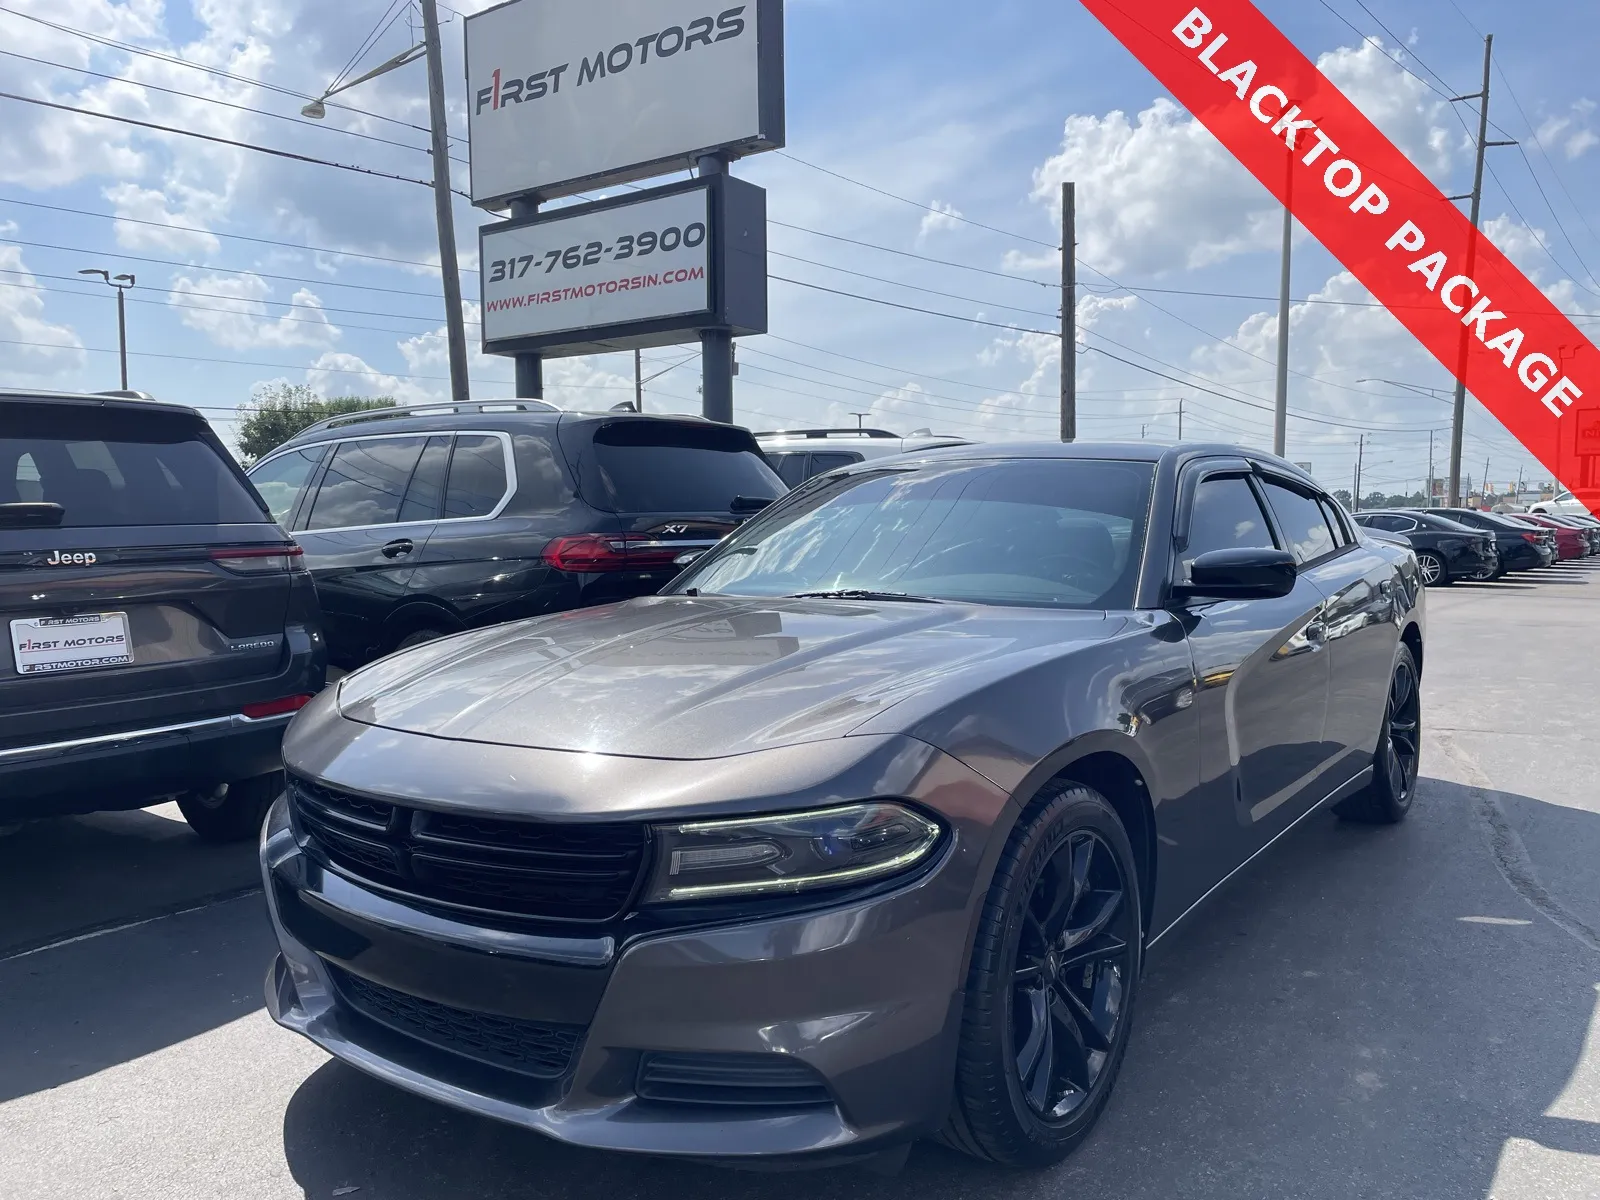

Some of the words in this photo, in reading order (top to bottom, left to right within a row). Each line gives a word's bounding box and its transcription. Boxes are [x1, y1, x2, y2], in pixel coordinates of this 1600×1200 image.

[576, 5, 746, 87] MOTORS
[488, 221, 706, 283] 317-762-3900
[486, 266, 704, 313] WWW.FIRSTMOTORSIN.COM
[662, 524, 689, 534] X7
[47, 550, 97, 567] Jeep
[65, 616, 100, 625] MOTORS
[63, 634, 125, 647] MOTORS
